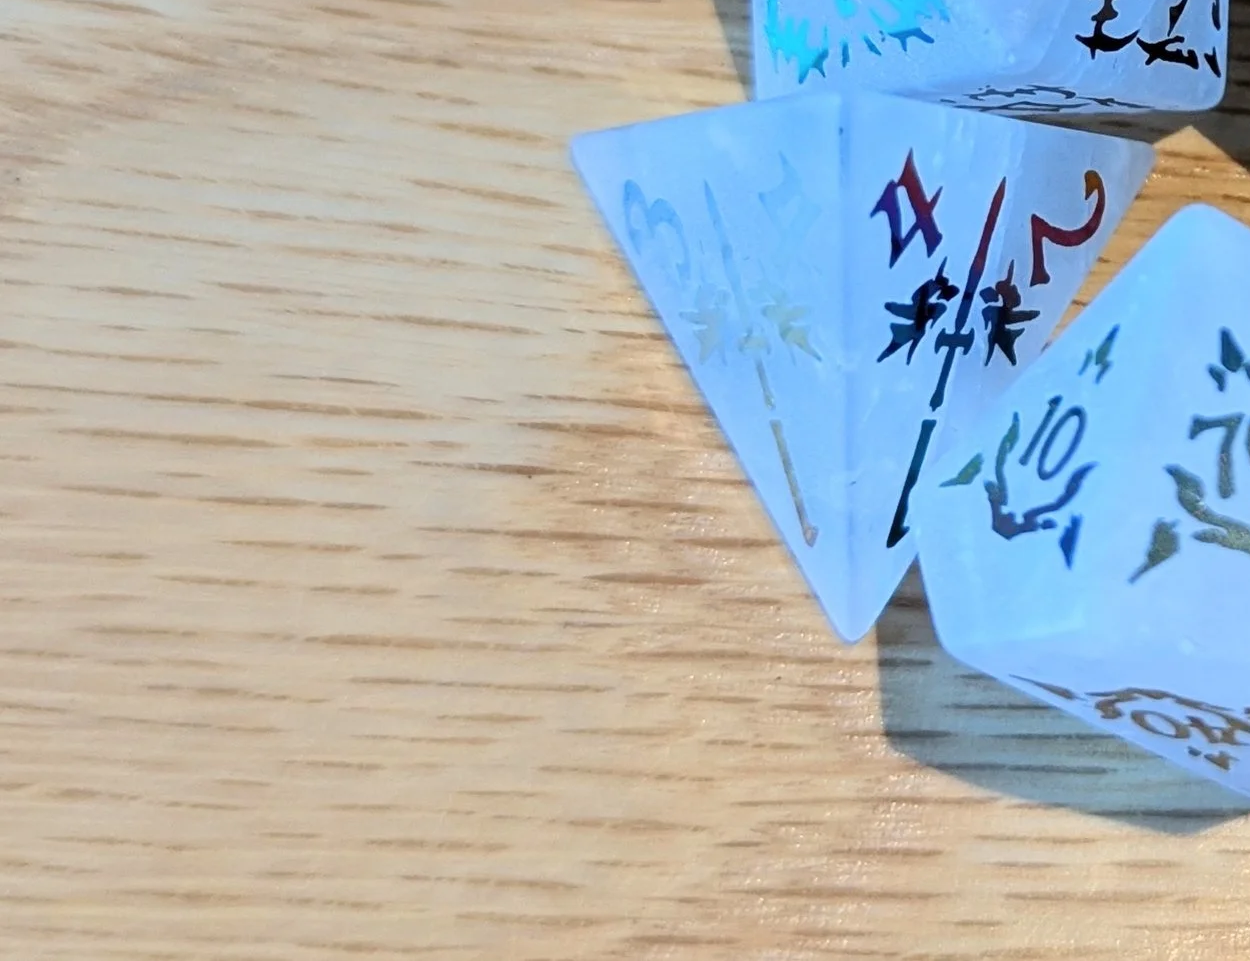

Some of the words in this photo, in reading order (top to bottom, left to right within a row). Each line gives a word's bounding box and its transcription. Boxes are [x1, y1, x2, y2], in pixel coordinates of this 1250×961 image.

[870, 147, 944, 269] 4
[1030, 170, 1106, 287] 2
[1018, 395, 1086, 481] 10
